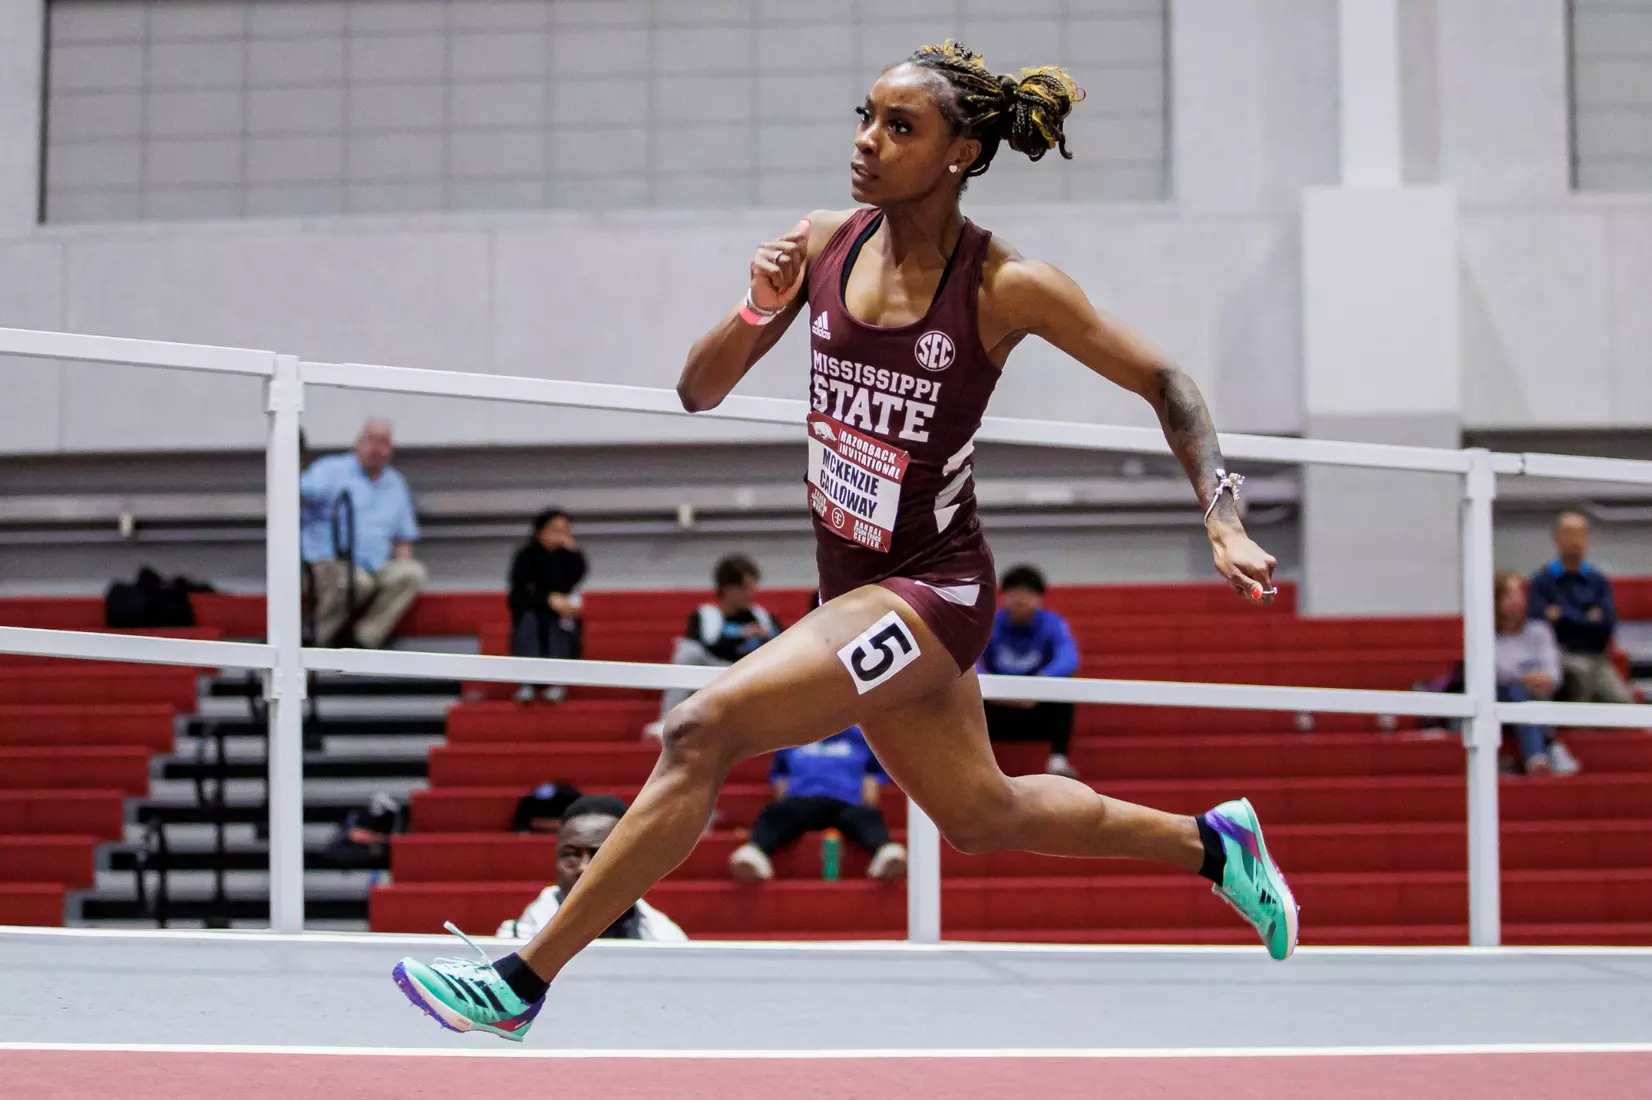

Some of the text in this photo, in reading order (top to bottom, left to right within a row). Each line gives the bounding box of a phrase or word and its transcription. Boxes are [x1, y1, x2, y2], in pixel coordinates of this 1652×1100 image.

[812, 325, 831, 340] adidas
[918, 333, 952, 370] SEC
[813, 350, 942, 402] MISSISSIPPI
[812, 375, 936, 443] STATE
[839, 444, 901, 480] INVITATIONAL
[840, 431, 897, 464] RAZORBACK
[819, 469, 878, 519] CALLOWAY
[822, 448, 880, 497] MCKENZIE
[853, 532, 880, 549] CENTER
[851, 622, 912, 681] 5
